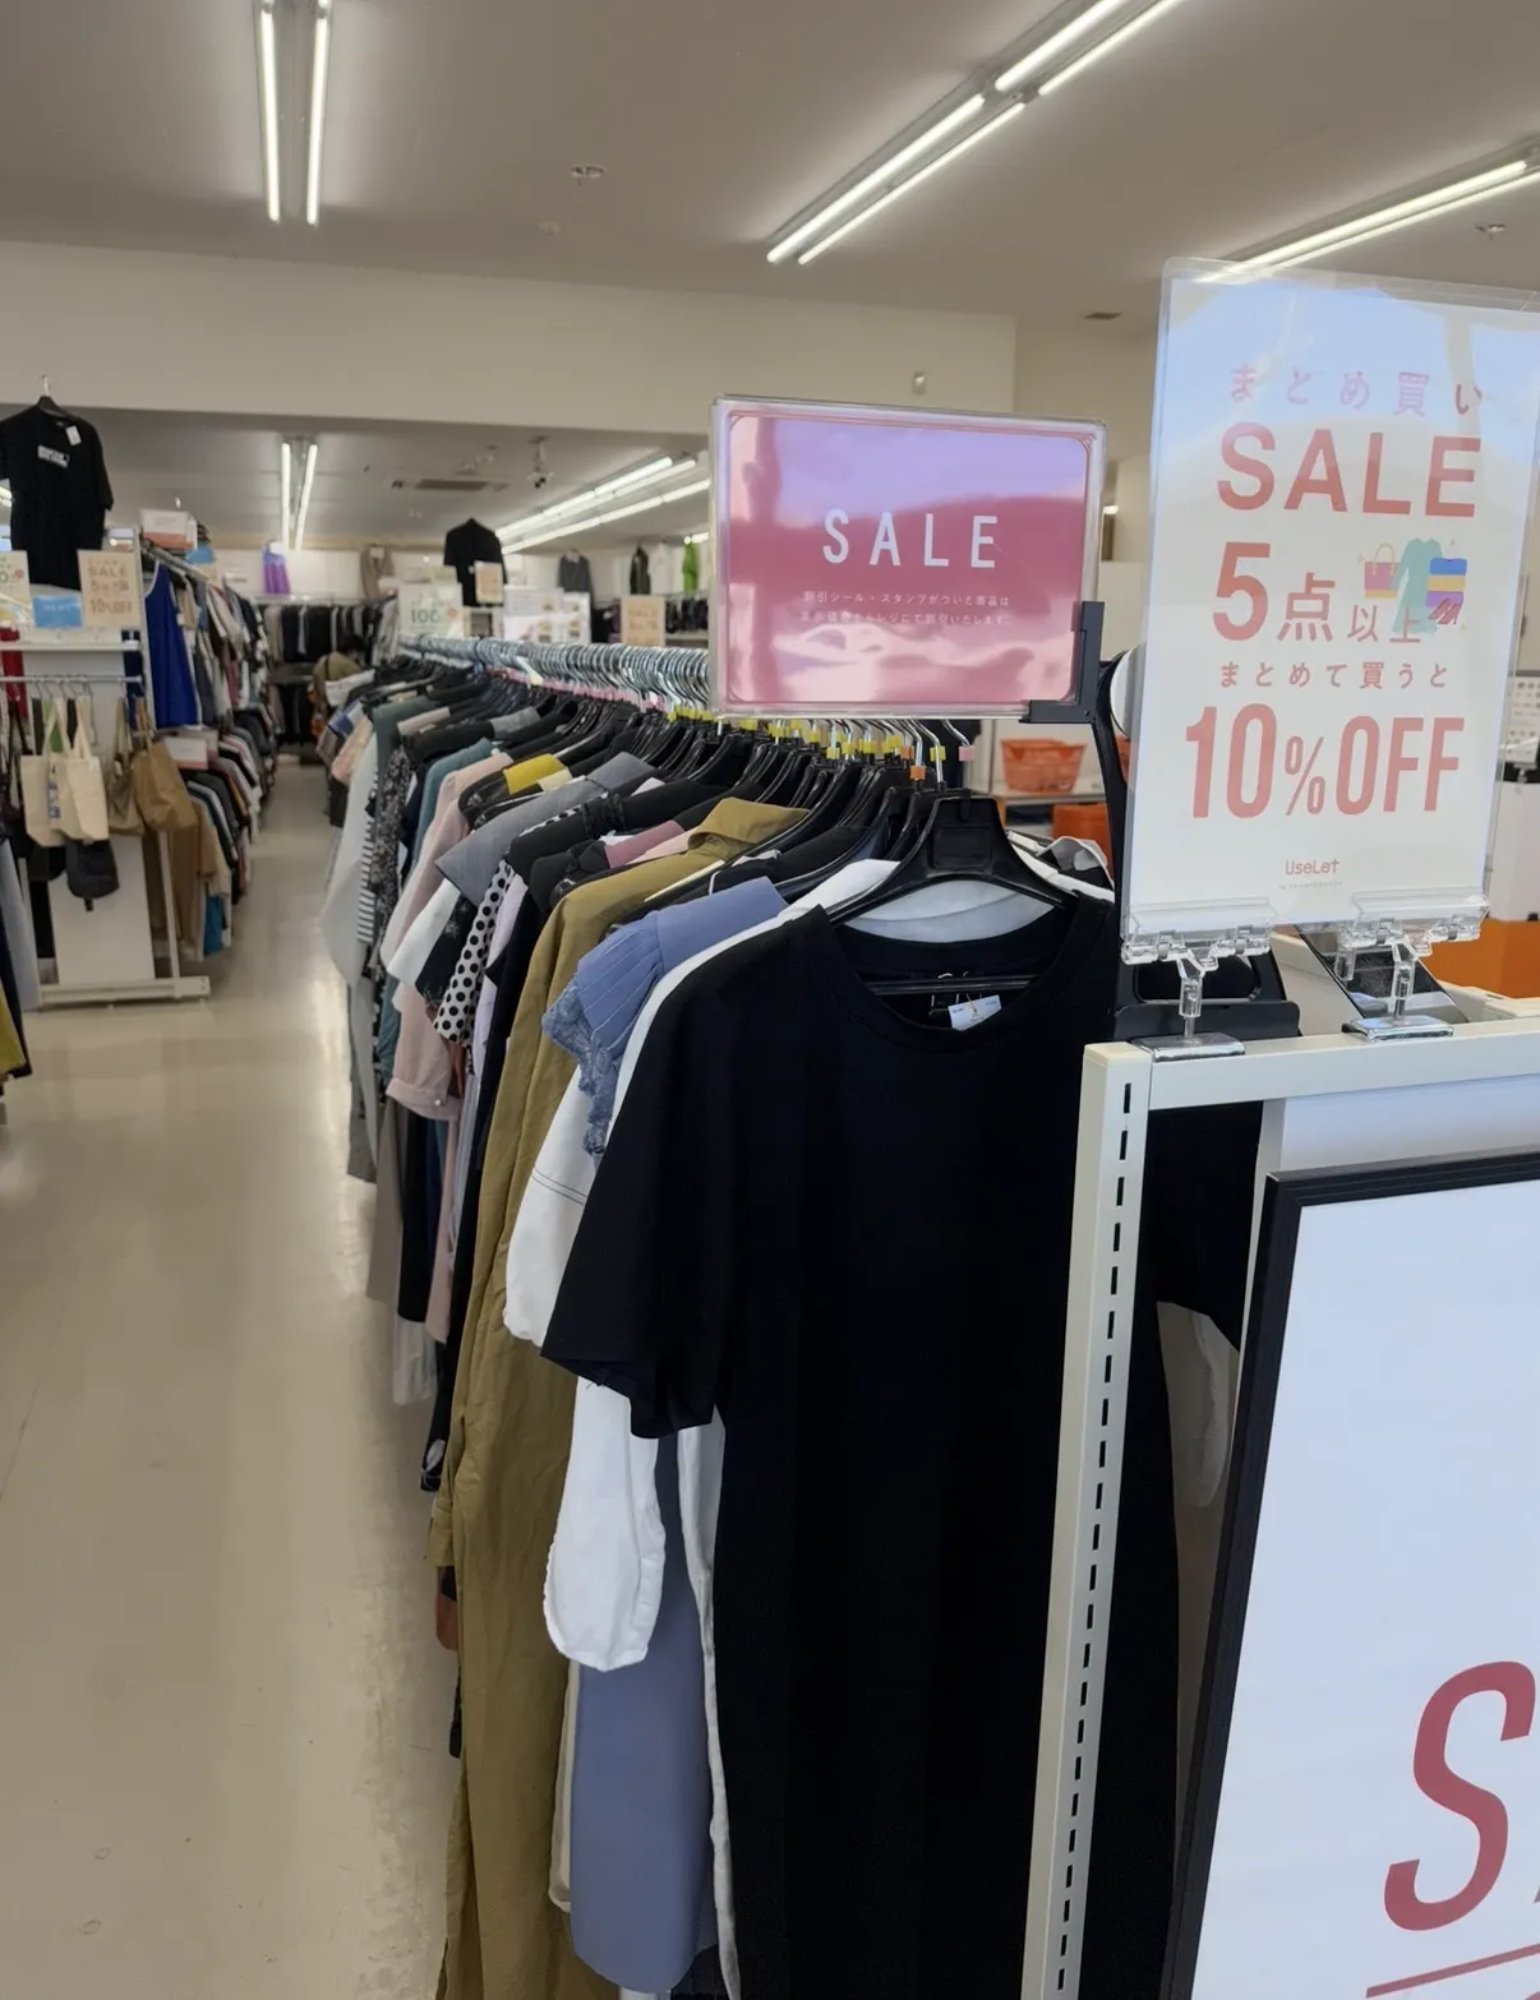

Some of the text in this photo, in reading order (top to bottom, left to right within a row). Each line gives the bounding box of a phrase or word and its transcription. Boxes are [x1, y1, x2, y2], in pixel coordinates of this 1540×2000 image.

[1230, 362, 1483, 418] まとめ買い
[1217, 421, 1482, 518] SALE
[822, 508, 998, 568] SALE
[1220, 661, 1448, 690] まとめて買うと
[1185, 702, 1465, 819] 10%OFF
[1384, 1660, 1540, 1932] S
